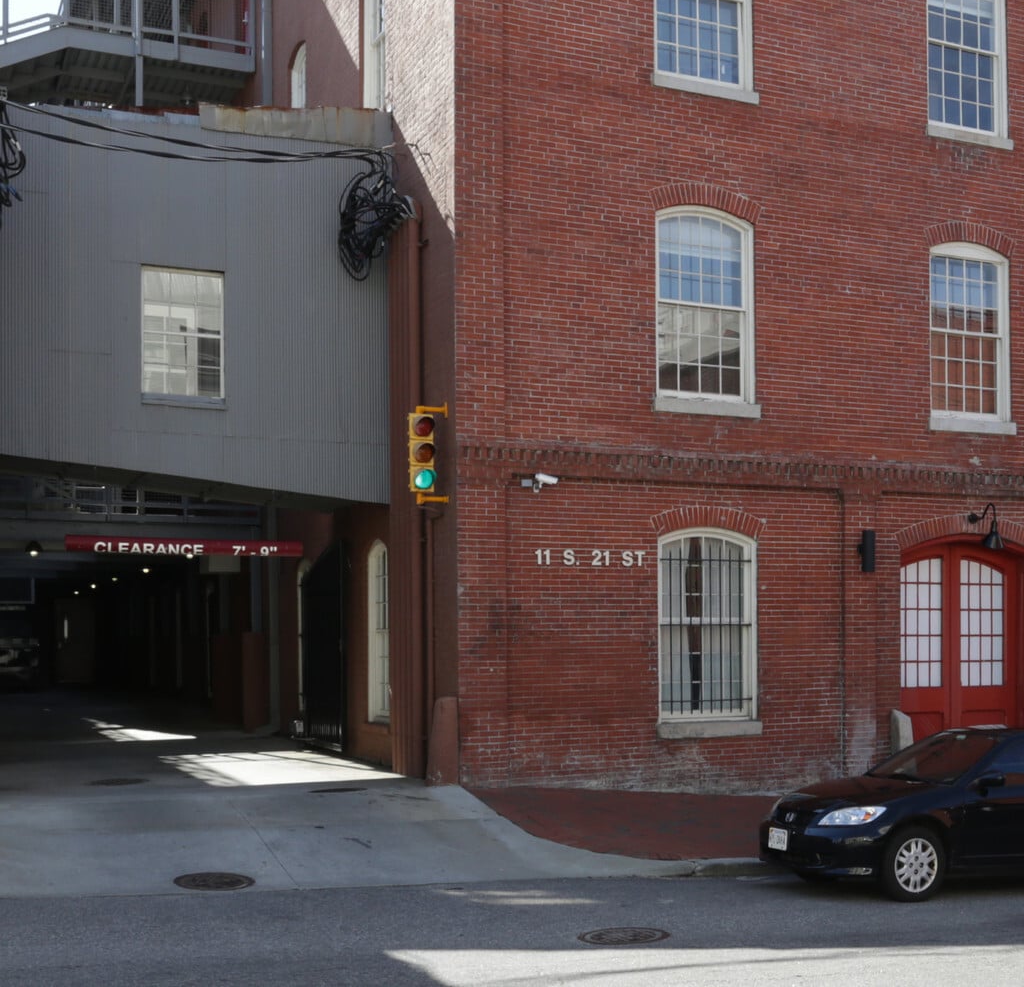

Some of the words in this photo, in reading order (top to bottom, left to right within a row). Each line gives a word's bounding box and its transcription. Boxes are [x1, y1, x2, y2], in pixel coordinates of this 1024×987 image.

[94, 541, 204, 555] CLEARANCE
[535, 548, 551, 565] 11
[563, 549, 580, 566] S.
[591, 549, 610, 566] 21
[622, 550, 646, 567] ST
